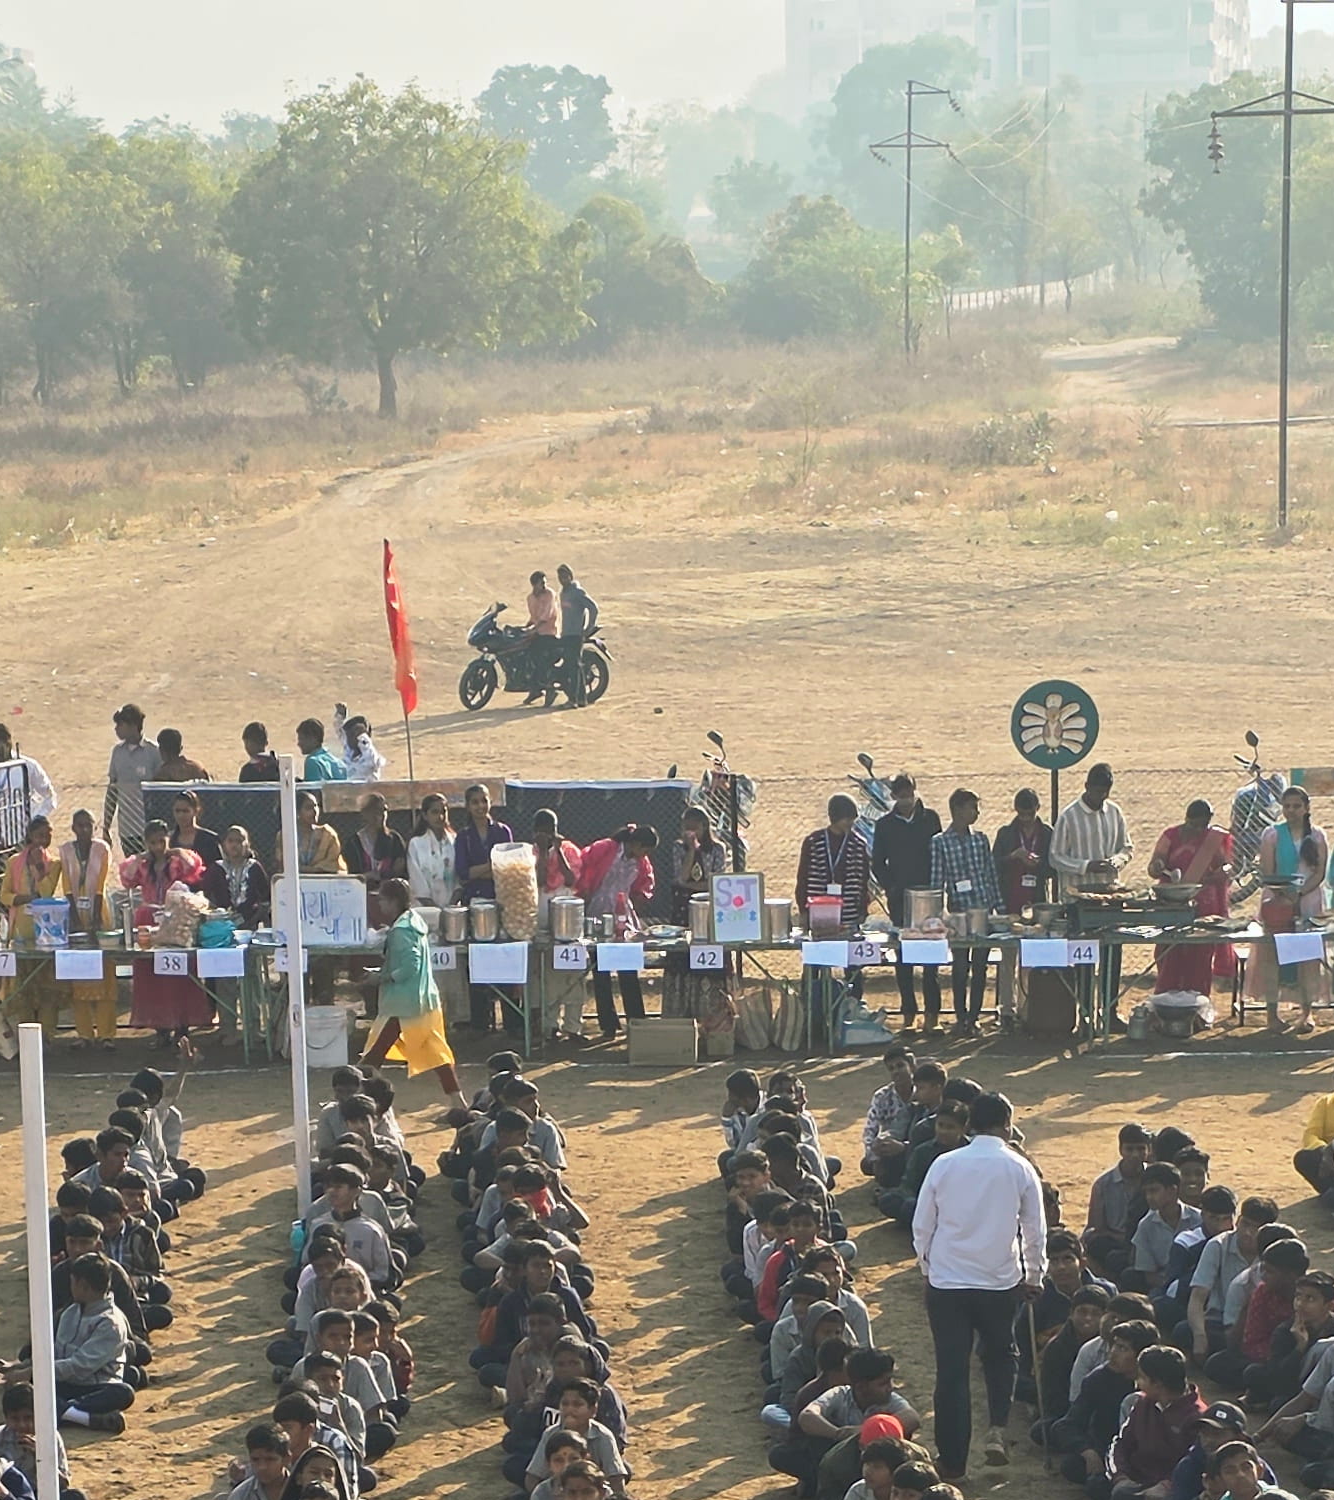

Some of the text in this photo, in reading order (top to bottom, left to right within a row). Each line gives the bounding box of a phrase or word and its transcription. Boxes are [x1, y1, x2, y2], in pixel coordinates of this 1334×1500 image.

[560, 947, 582, 961] 41
[854, 943, 874, 957] 43
[1072, 946, 1093, 960] 44
[161, 956, 180, 970] 38
[696, 951, 717, 966] 42
